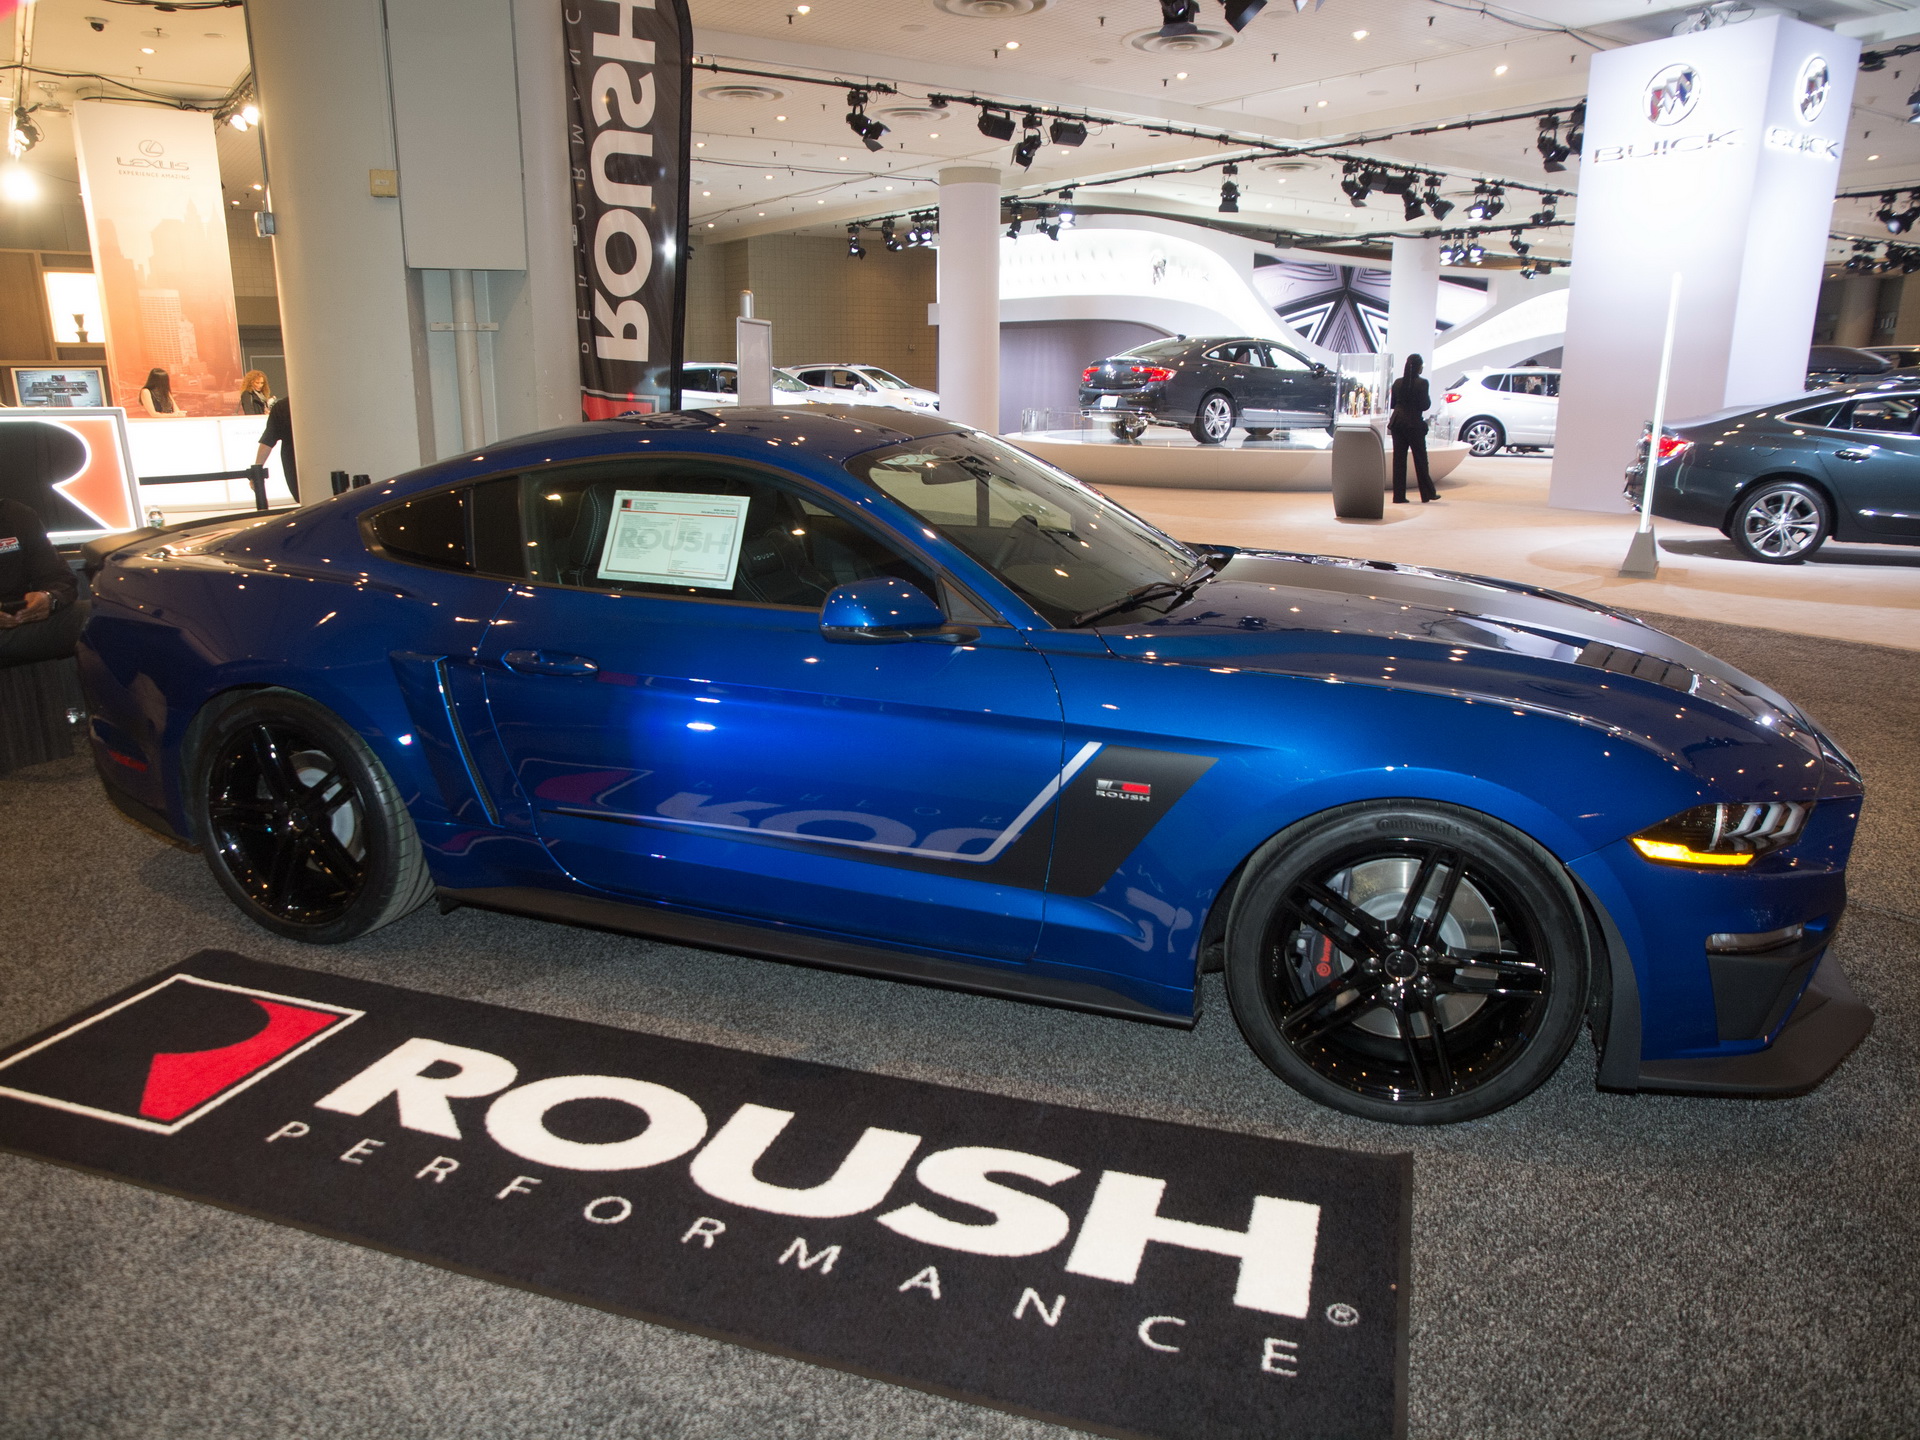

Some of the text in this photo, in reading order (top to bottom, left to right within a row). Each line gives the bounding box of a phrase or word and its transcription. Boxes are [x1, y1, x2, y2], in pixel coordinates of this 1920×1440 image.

[1592, 127, 1745, 164] BUICK
[116, 156, 190, 171] LEXUS
[118, 169, 159, 178] EXPERIENCE
[616, 527, 729, 555] ROUSH
[1095, 789, 1151, 803] ROUSH
[315, 1037, 1321, 1319] ROUSH
[266, 1121, 1299, 1377] PERFORMANCE
